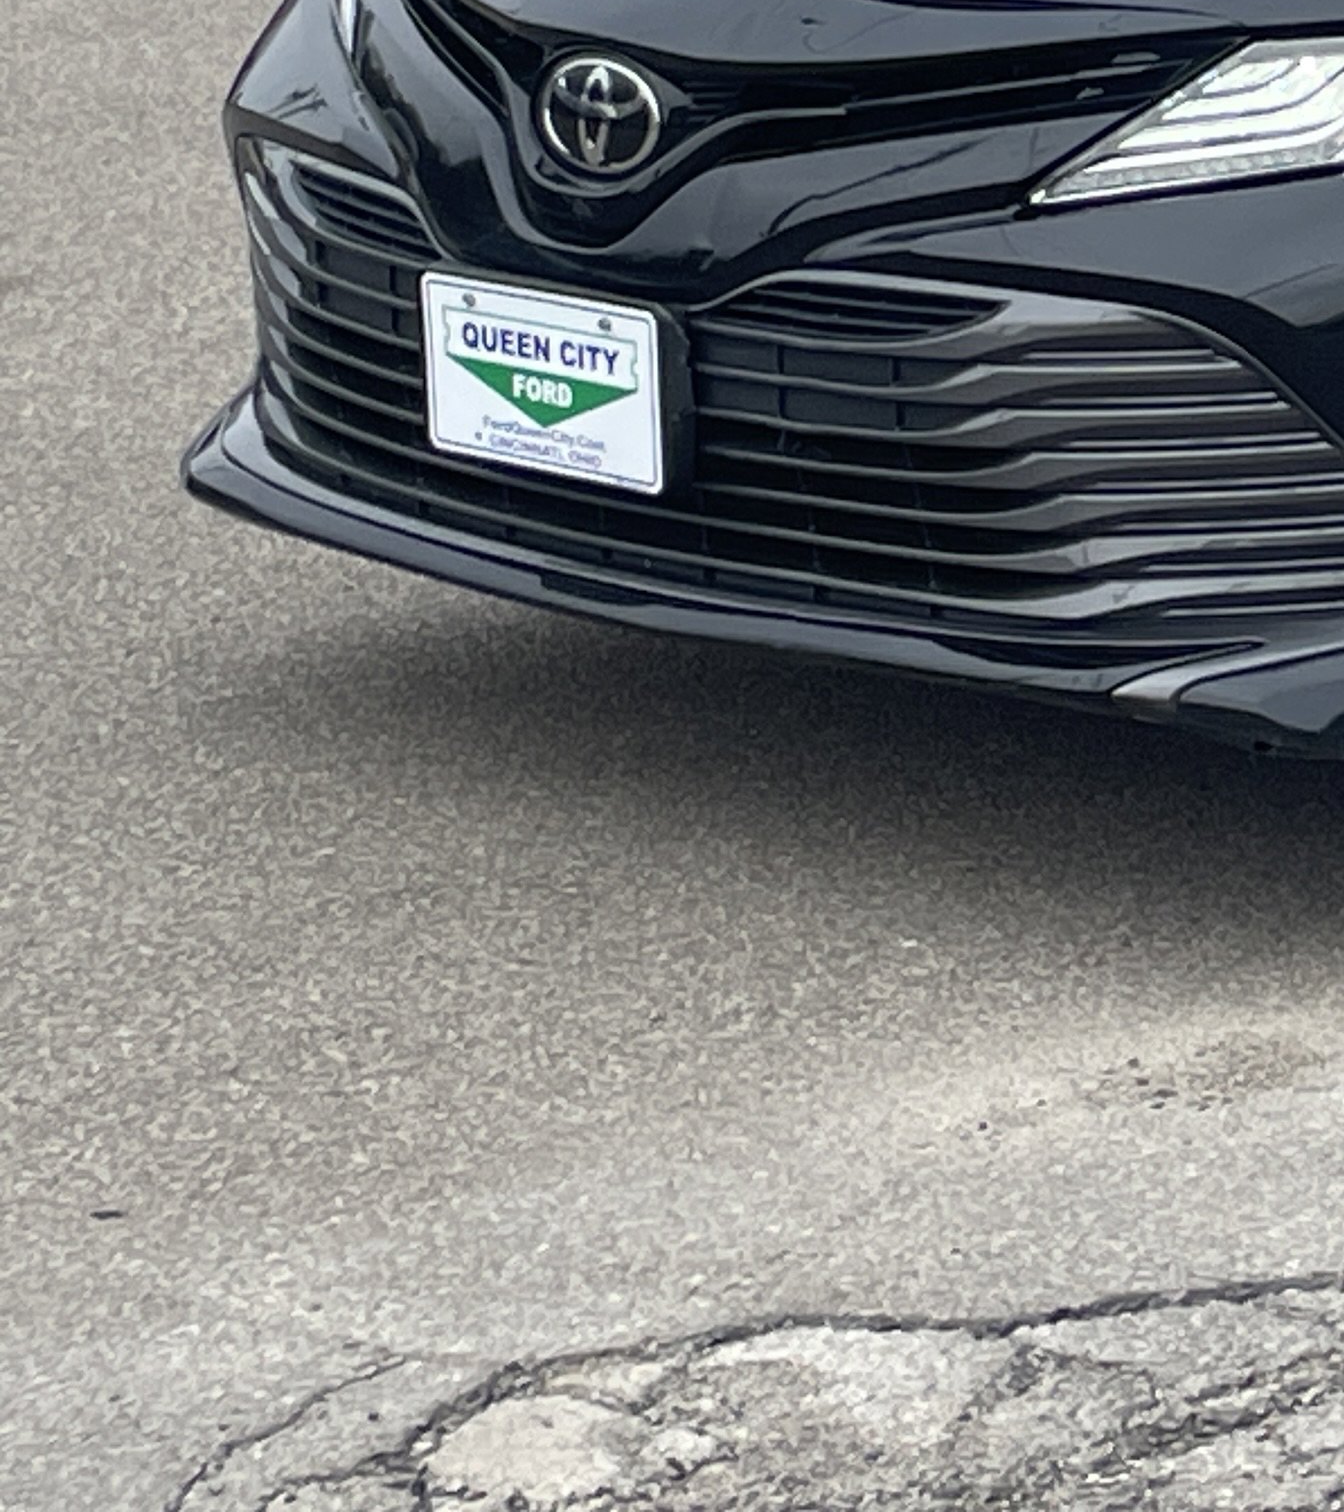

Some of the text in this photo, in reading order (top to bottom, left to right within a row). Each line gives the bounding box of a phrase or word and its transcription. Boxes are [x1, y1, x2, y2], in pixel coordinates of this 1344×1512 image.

[462, 322, 620, 376] QUEEN CITY
[512, 373, 574, 409] FORD
